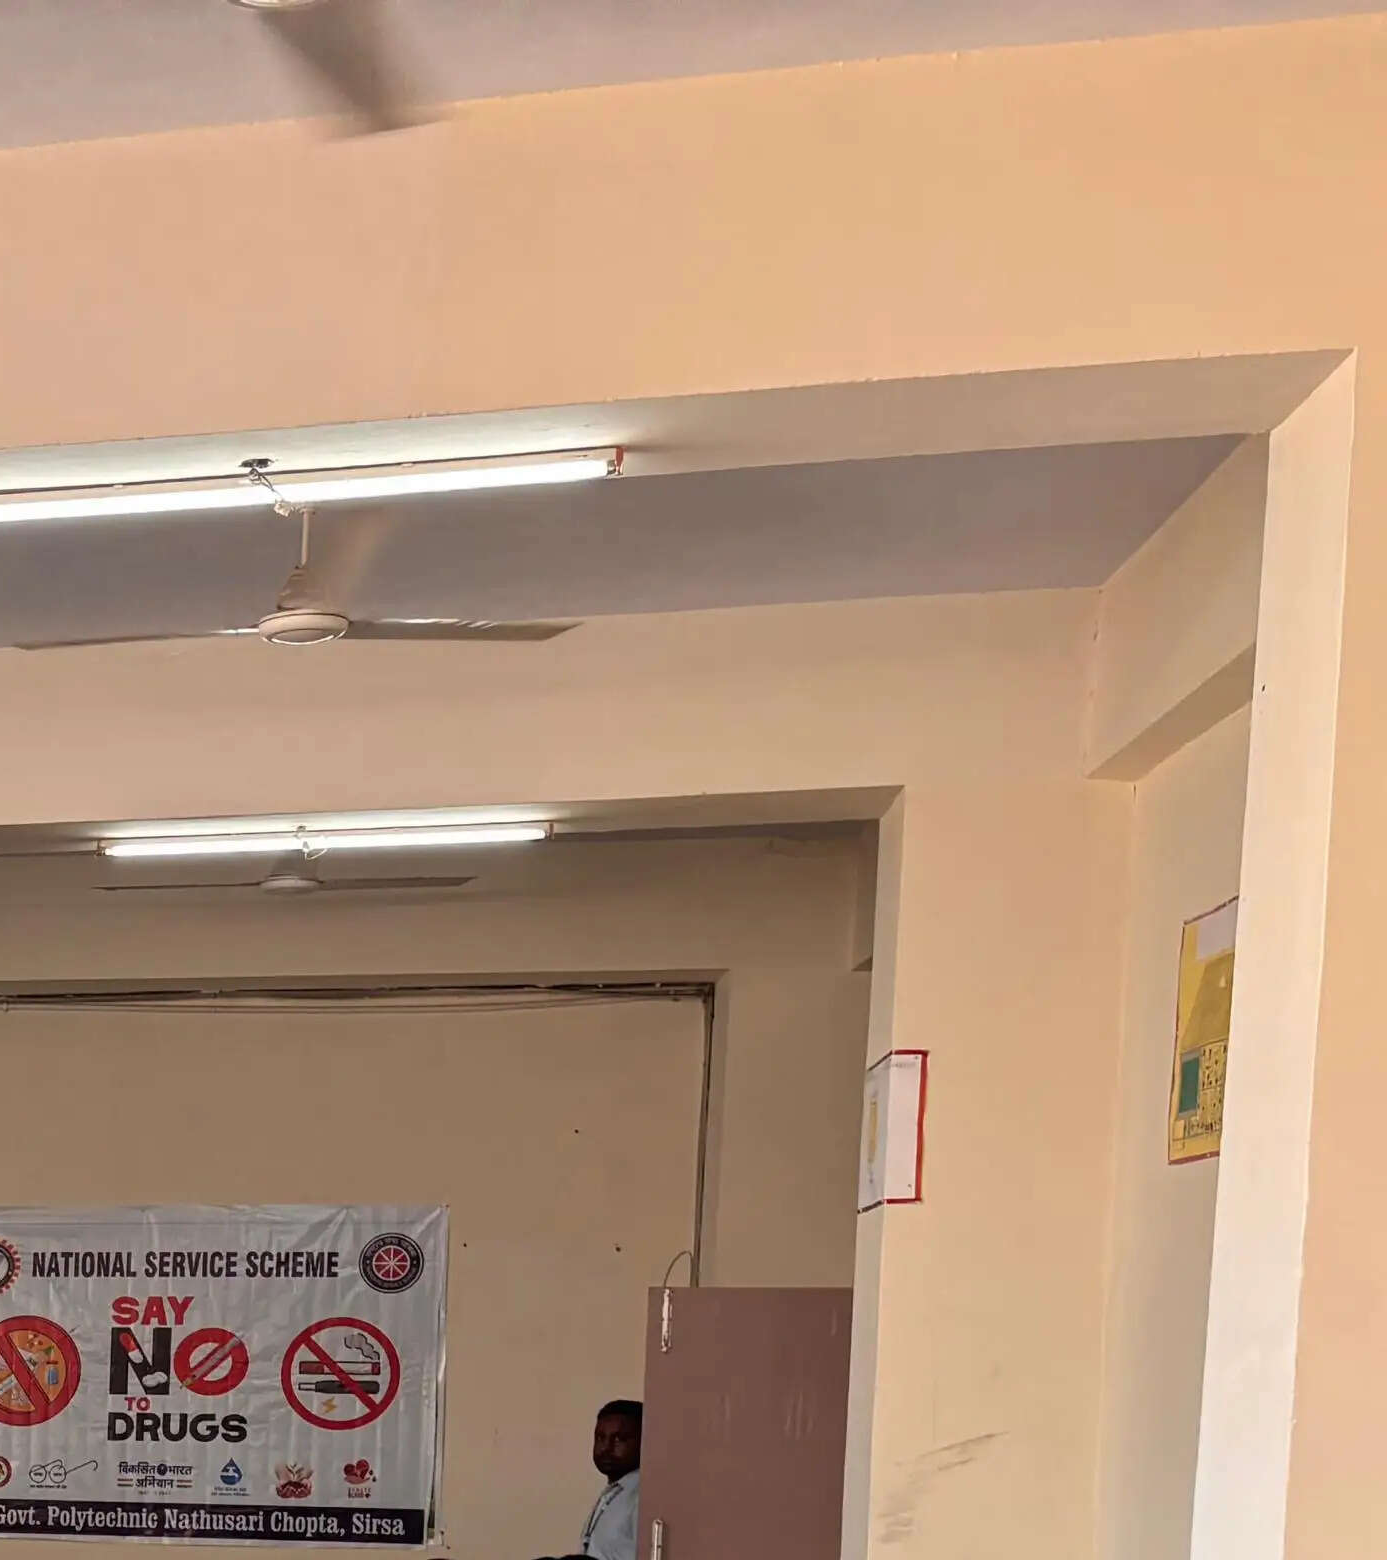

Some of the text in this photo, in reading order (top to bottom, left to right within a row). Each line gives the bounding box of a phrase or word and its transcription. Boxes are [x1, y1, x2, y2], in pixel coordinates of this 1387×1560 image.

[32, 1252, 136, 1277] NATIONAL
[144, 1251, 237, 1278] SERVICE
[245, 1251, 339, 1278] SCHEME
[112, 1296, 195, 1326] SAY
[124, 1397, 150, 1411] TO
[108, 1412, 248, 1443] DRUGS
[119, 1461, 193, 1475] विकसित भारत
[47, 1506, 158, 1532] Polytechnic
[163, 1508, 264, 1533] Nathusari
[270, 1511, 346, 1537] Chopta,
[352, 1513, 406, 1536] Sirsa
